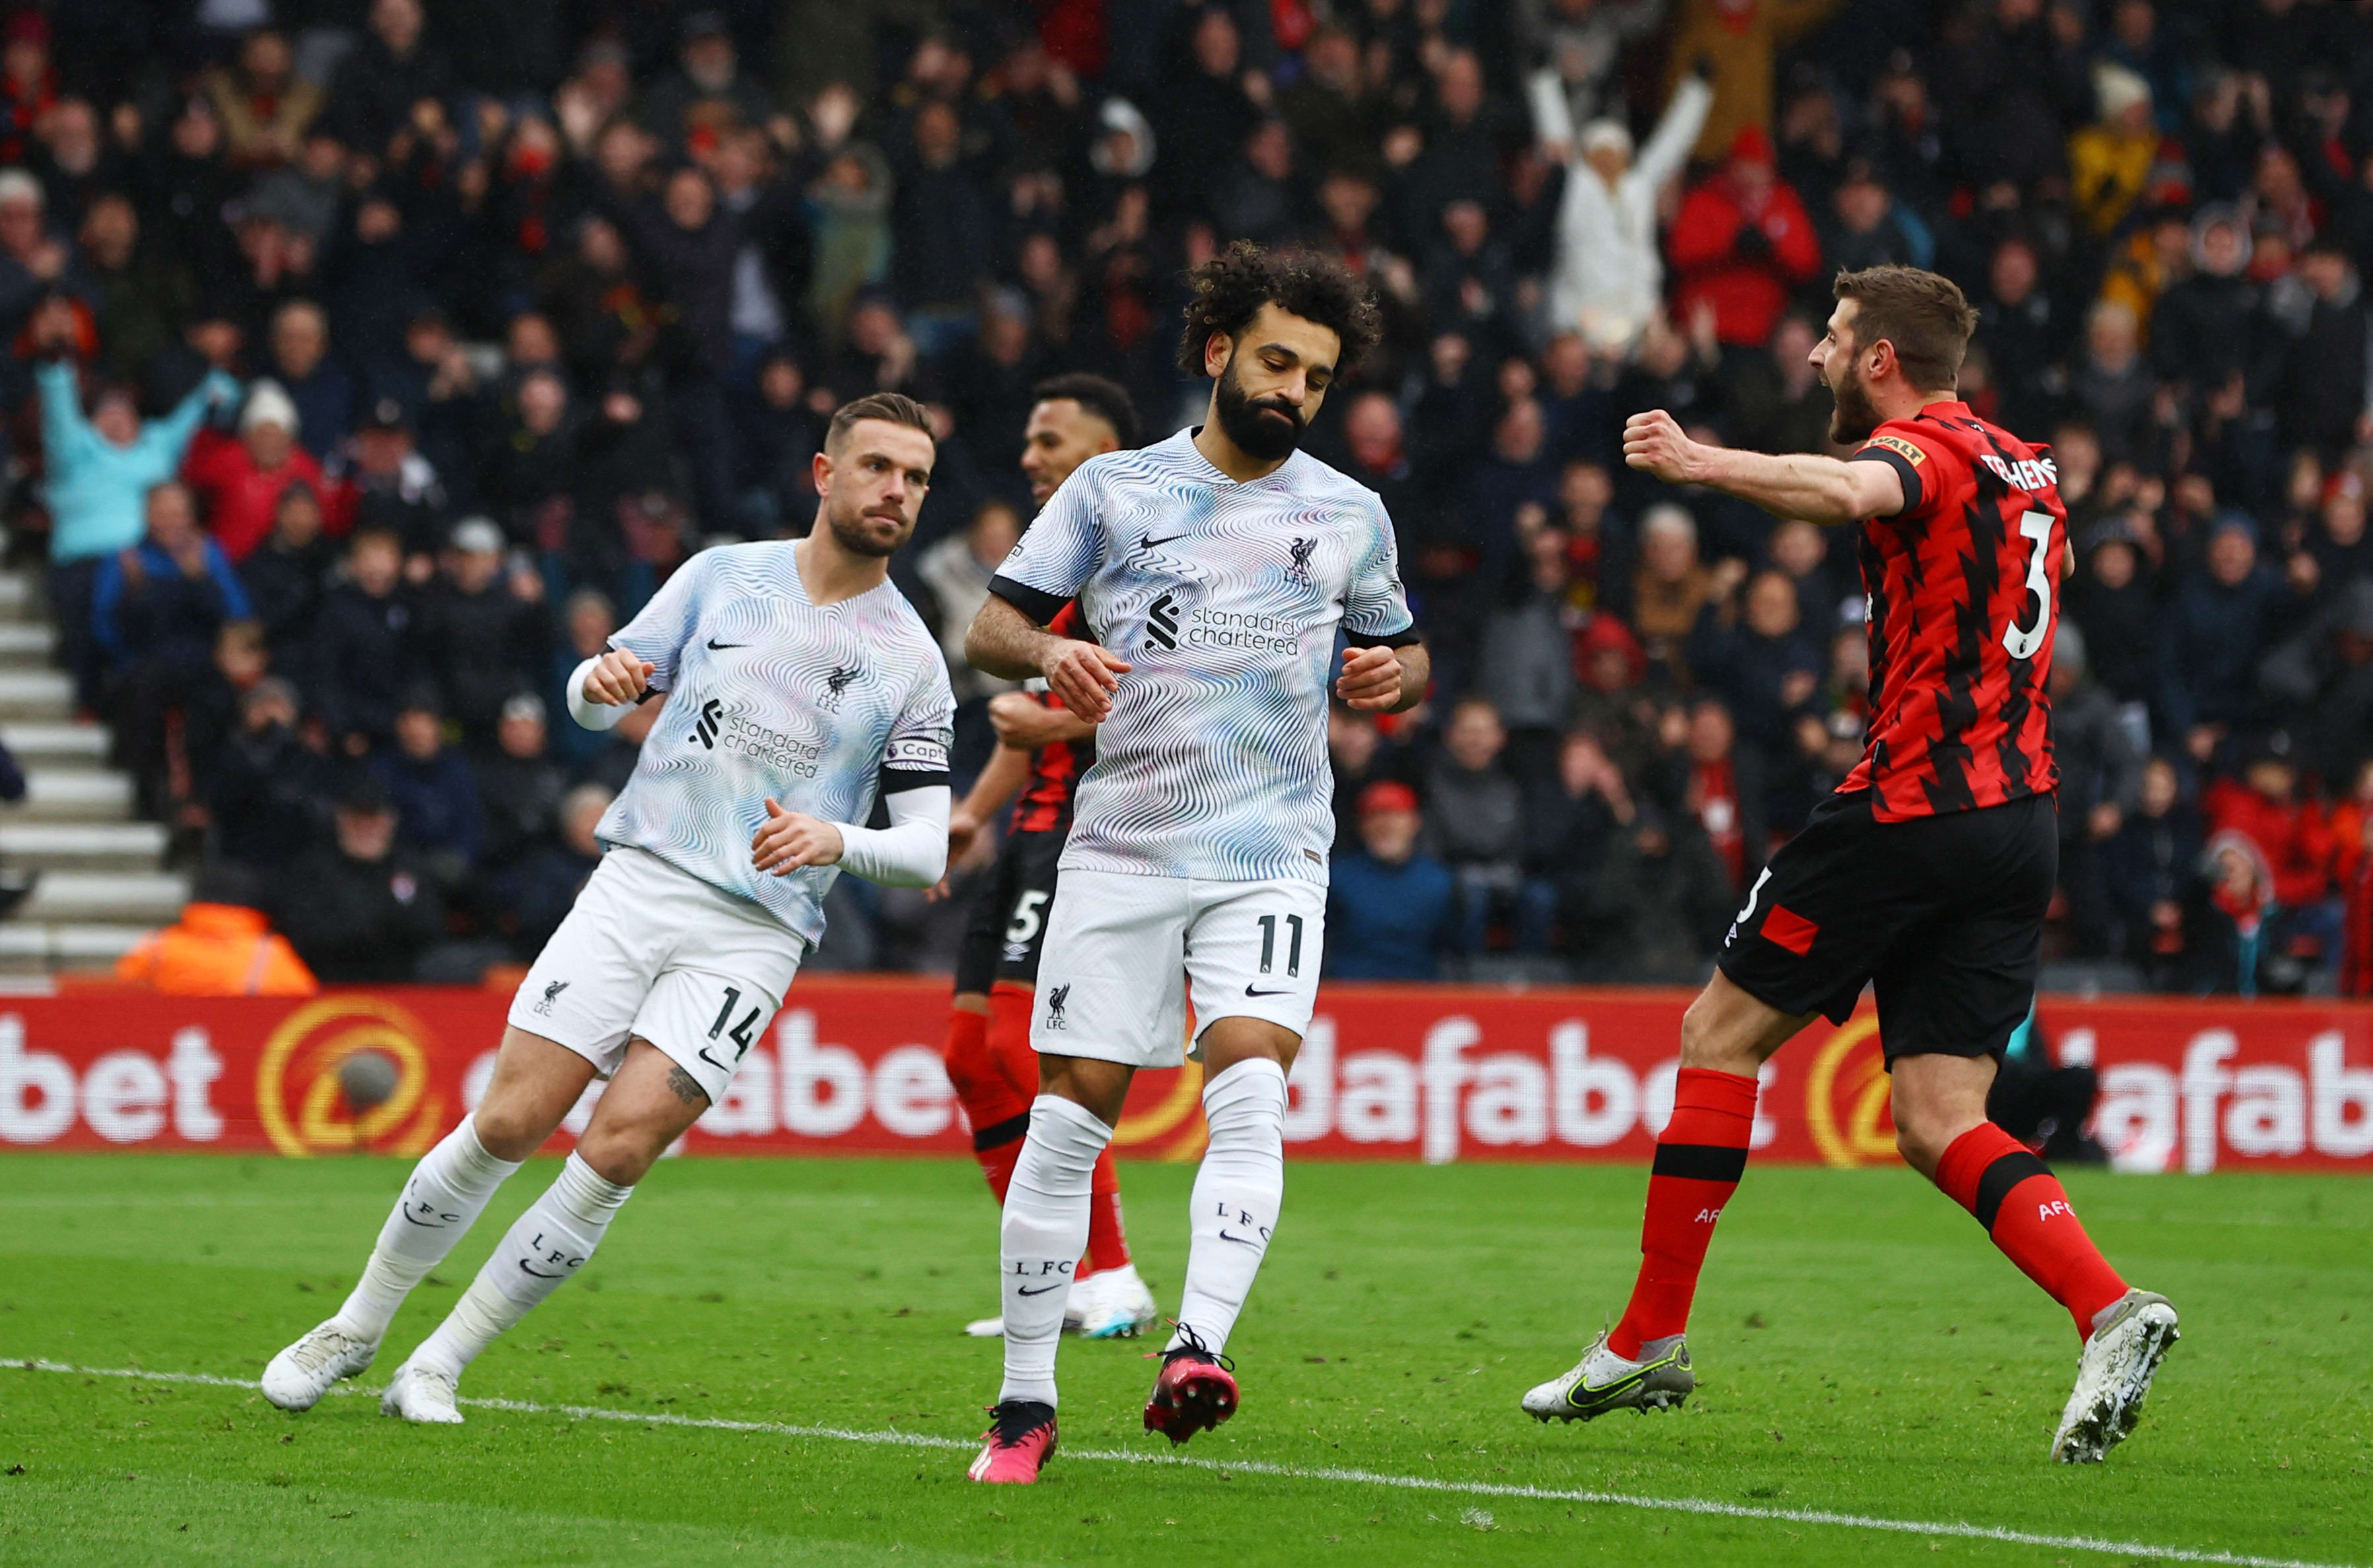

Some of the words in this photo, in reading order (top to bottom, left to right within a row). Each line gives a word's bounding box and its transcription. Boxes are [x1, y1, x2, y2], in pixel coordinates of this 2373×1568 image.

[2002, 510, 2056, 660] 3
[1189, 625, 1298, 656] chartered
[1191, 606, 1295, 637] standard
[724, 734, 819, 778] chartered
[729, 717, 820, 760] standard
[1006, 889, 1050, 943] 5
[1257, 913, 1303, 978] 11
[708, 986, 761, 1063] 14
[2057, 1026, 2373, 1175] afab
[1694, 1208, 1722, 1223] AF
